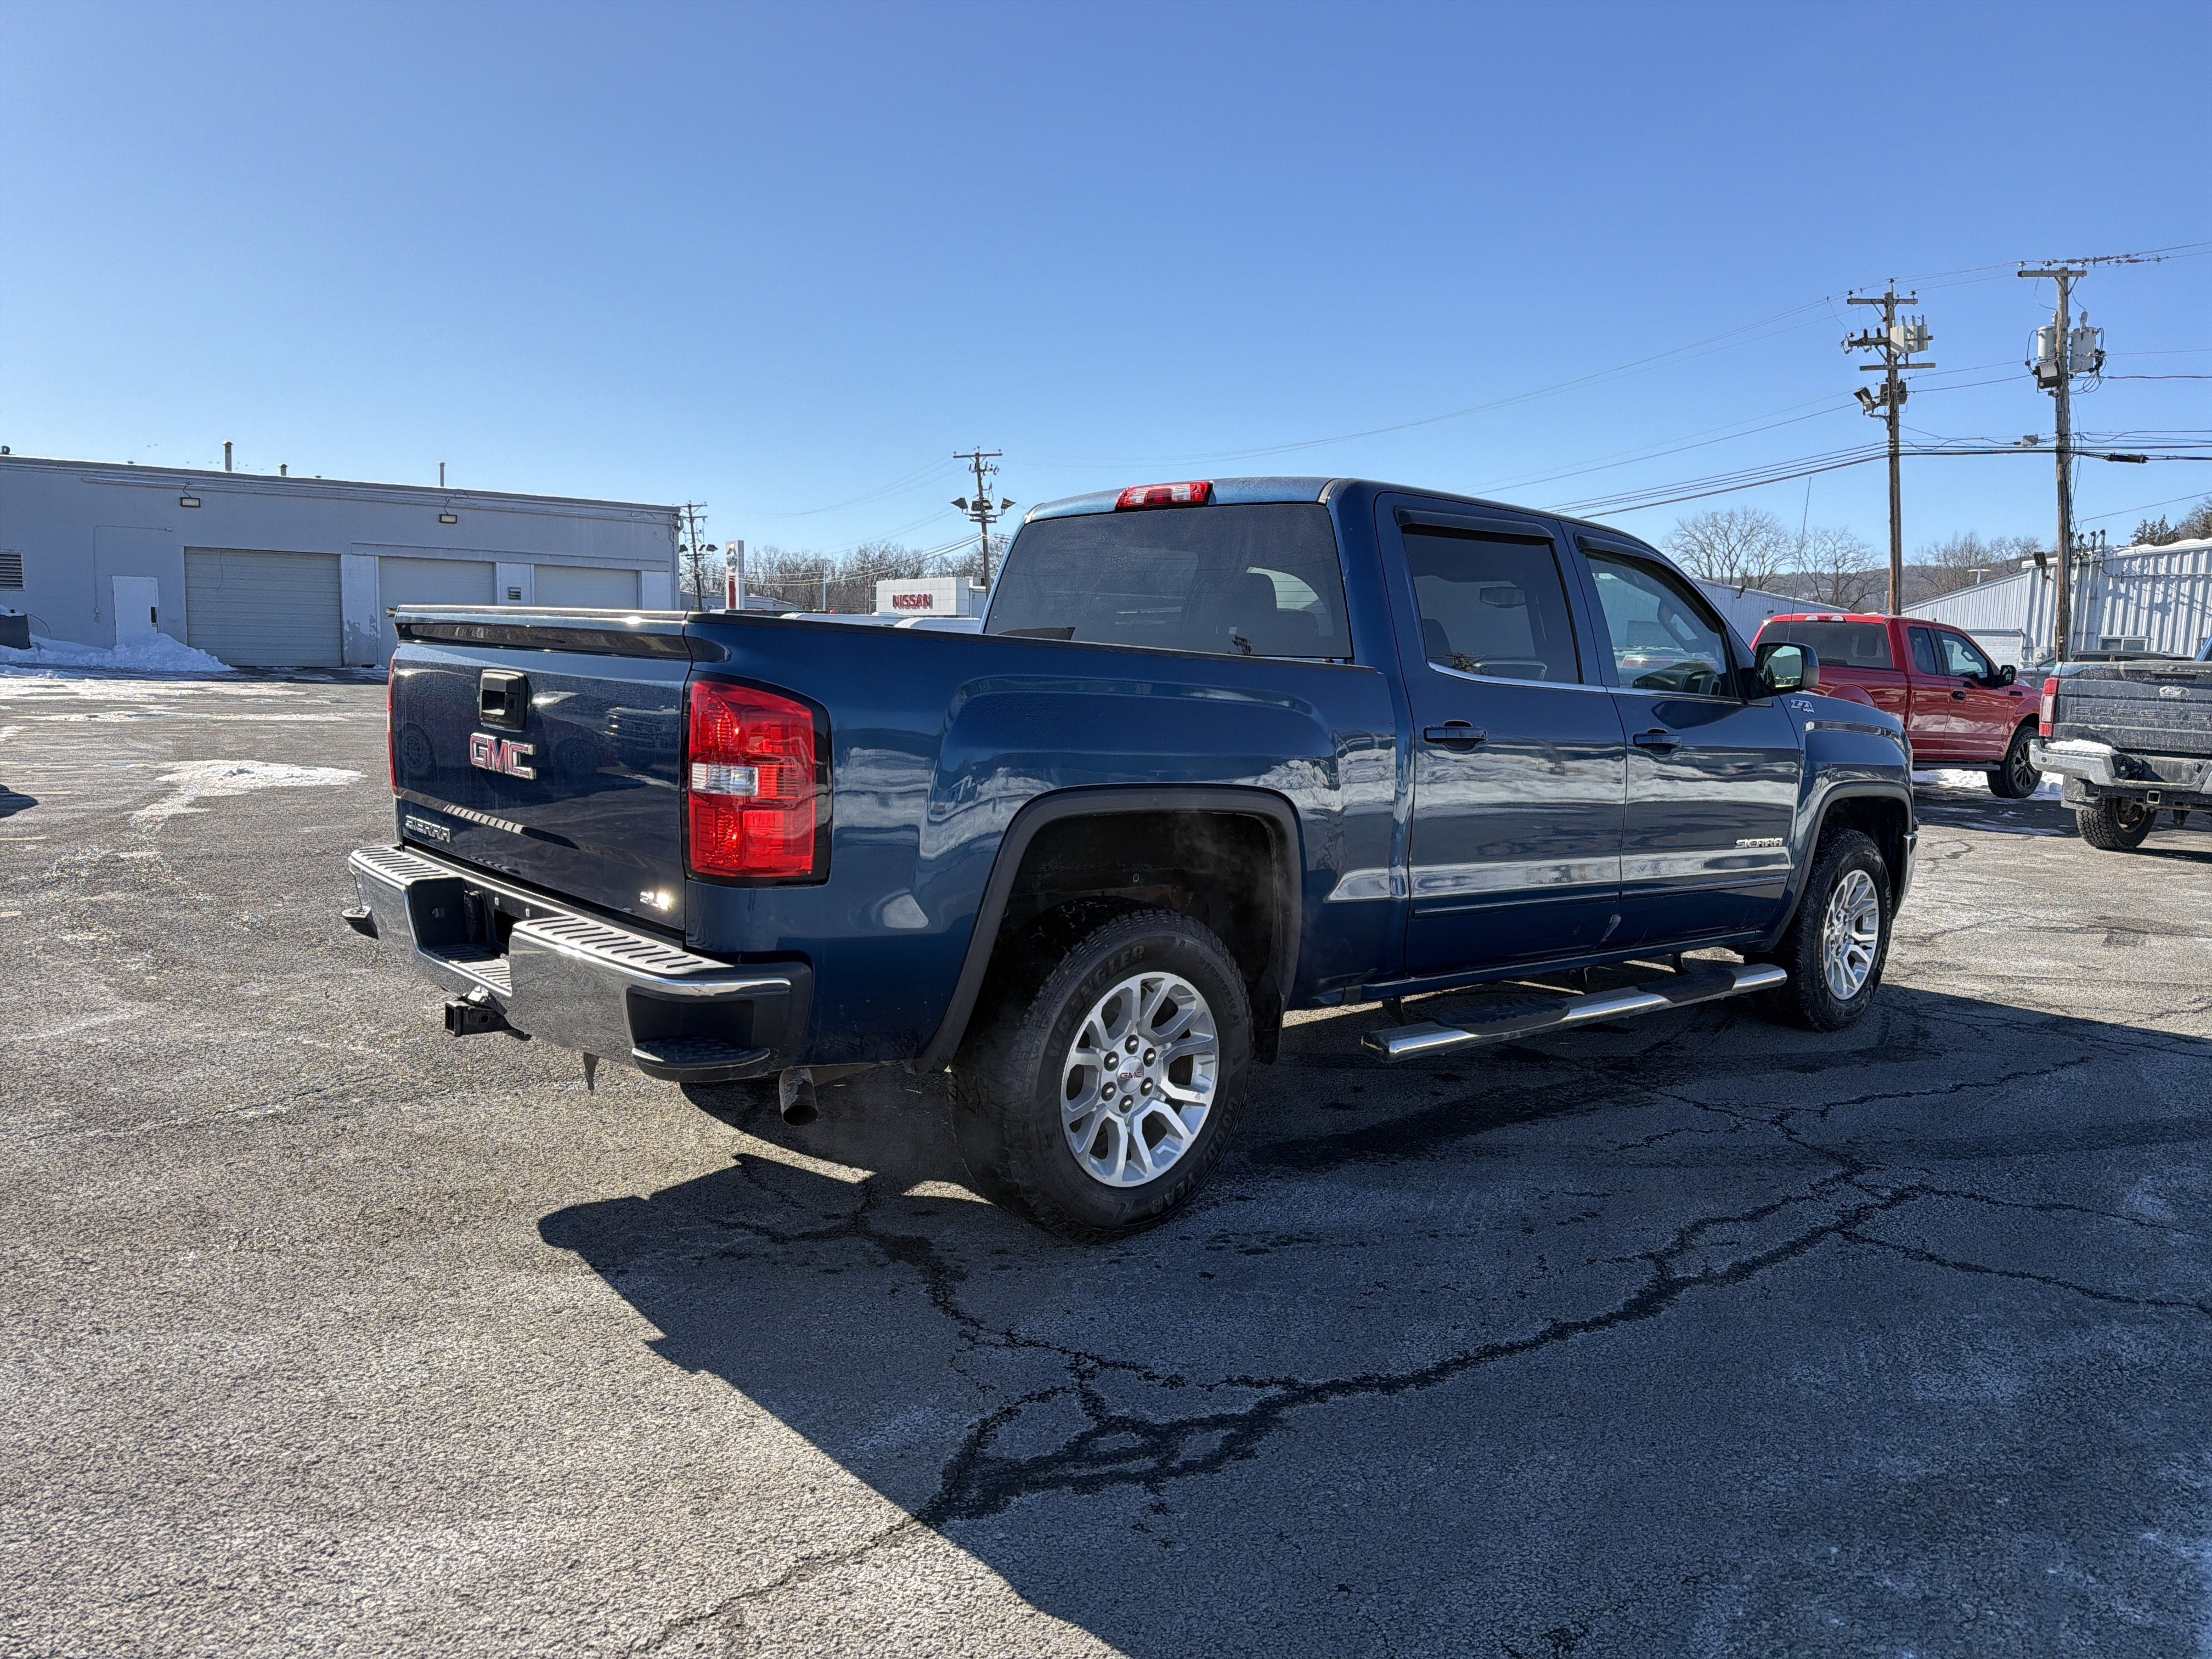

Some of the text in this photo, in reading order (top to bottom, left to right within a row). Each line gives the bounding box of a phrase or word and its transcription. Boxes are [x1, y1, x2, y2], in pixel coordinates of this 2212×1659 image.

[893, 594, 933, 610] NISSAN
[470, 732, 537, 779] GMC
[405, 815, 452, 843] SIERRA
[1735, 838, 1783, 848] SIERRA
[1048, 945, 1146, 1057] WRANGLER
